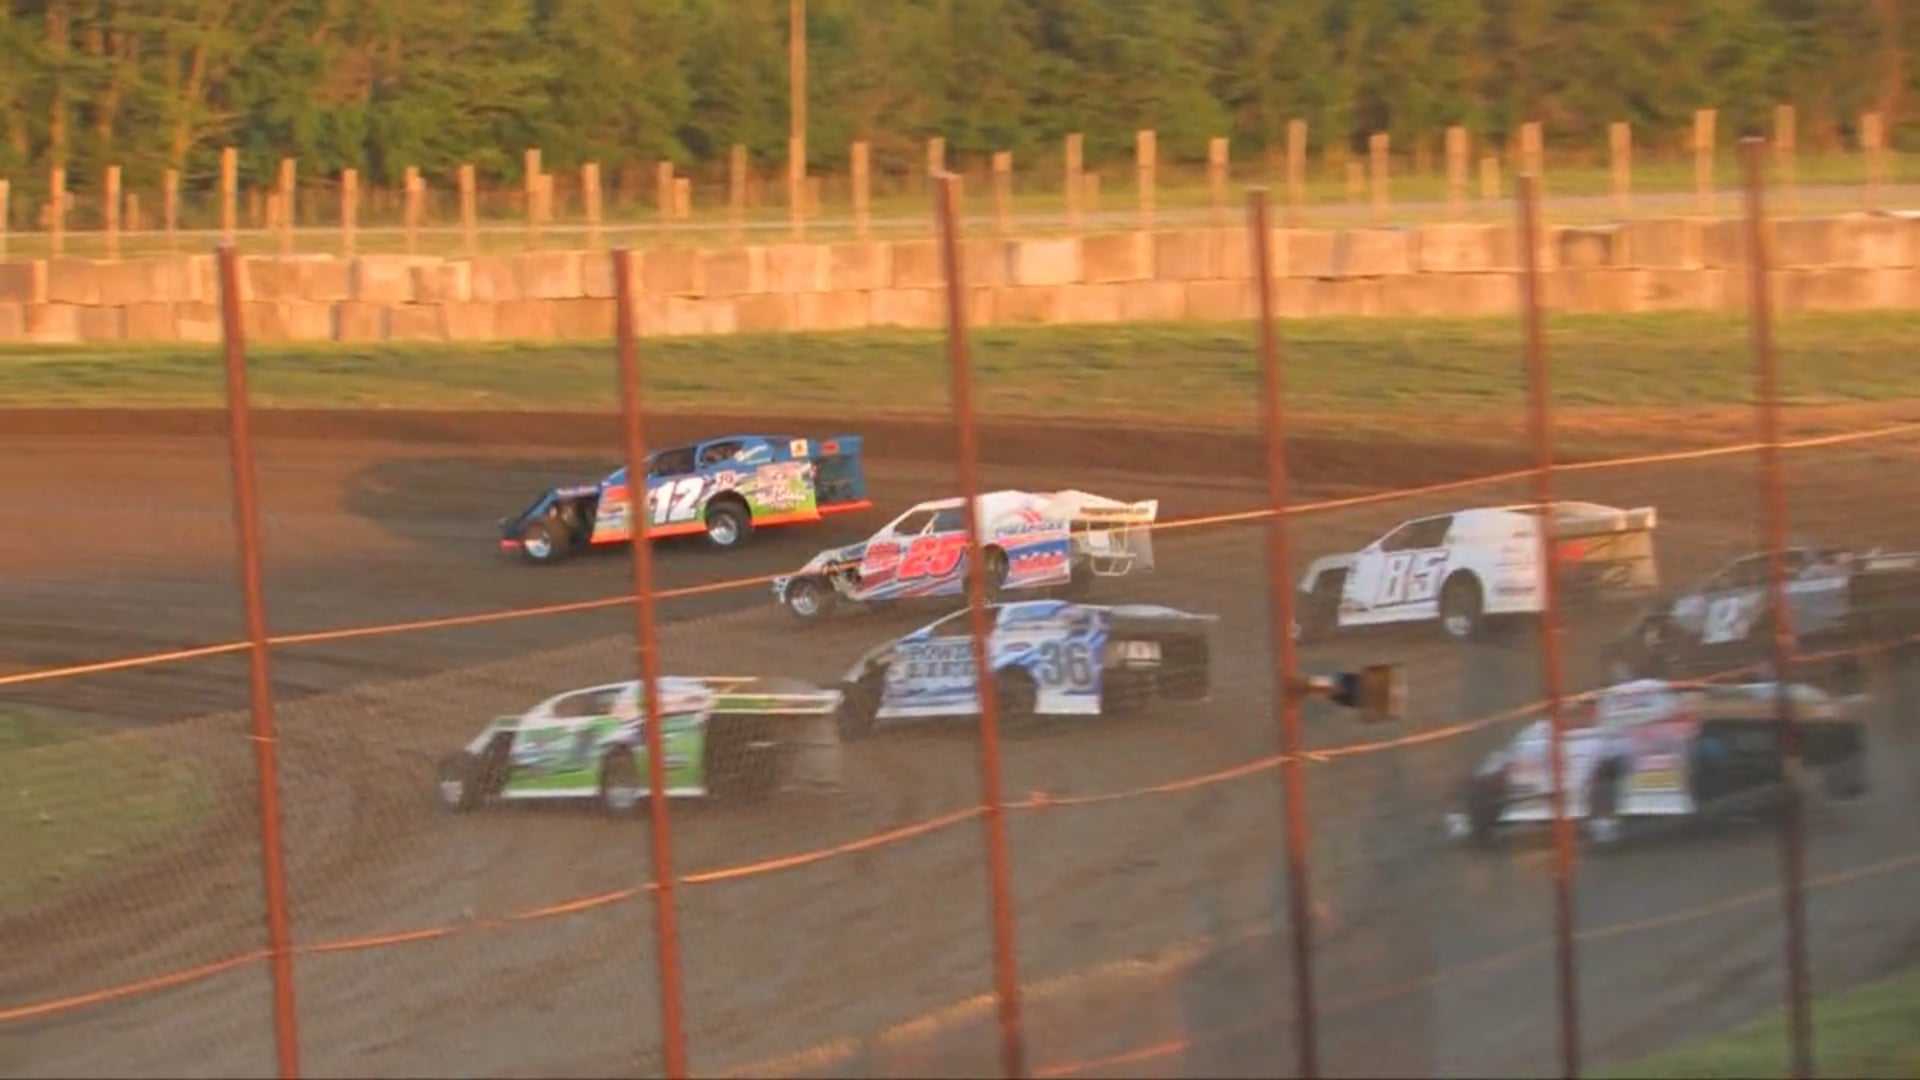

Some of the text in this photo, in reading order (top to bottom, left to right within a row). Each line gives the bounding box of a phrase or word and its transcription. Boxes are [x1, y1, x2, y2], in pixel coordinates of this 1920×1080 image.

[653, 476, 705, 525] 12
[897, 533, 972, 580] 25
[1040, 641, 1095, 687] 36
